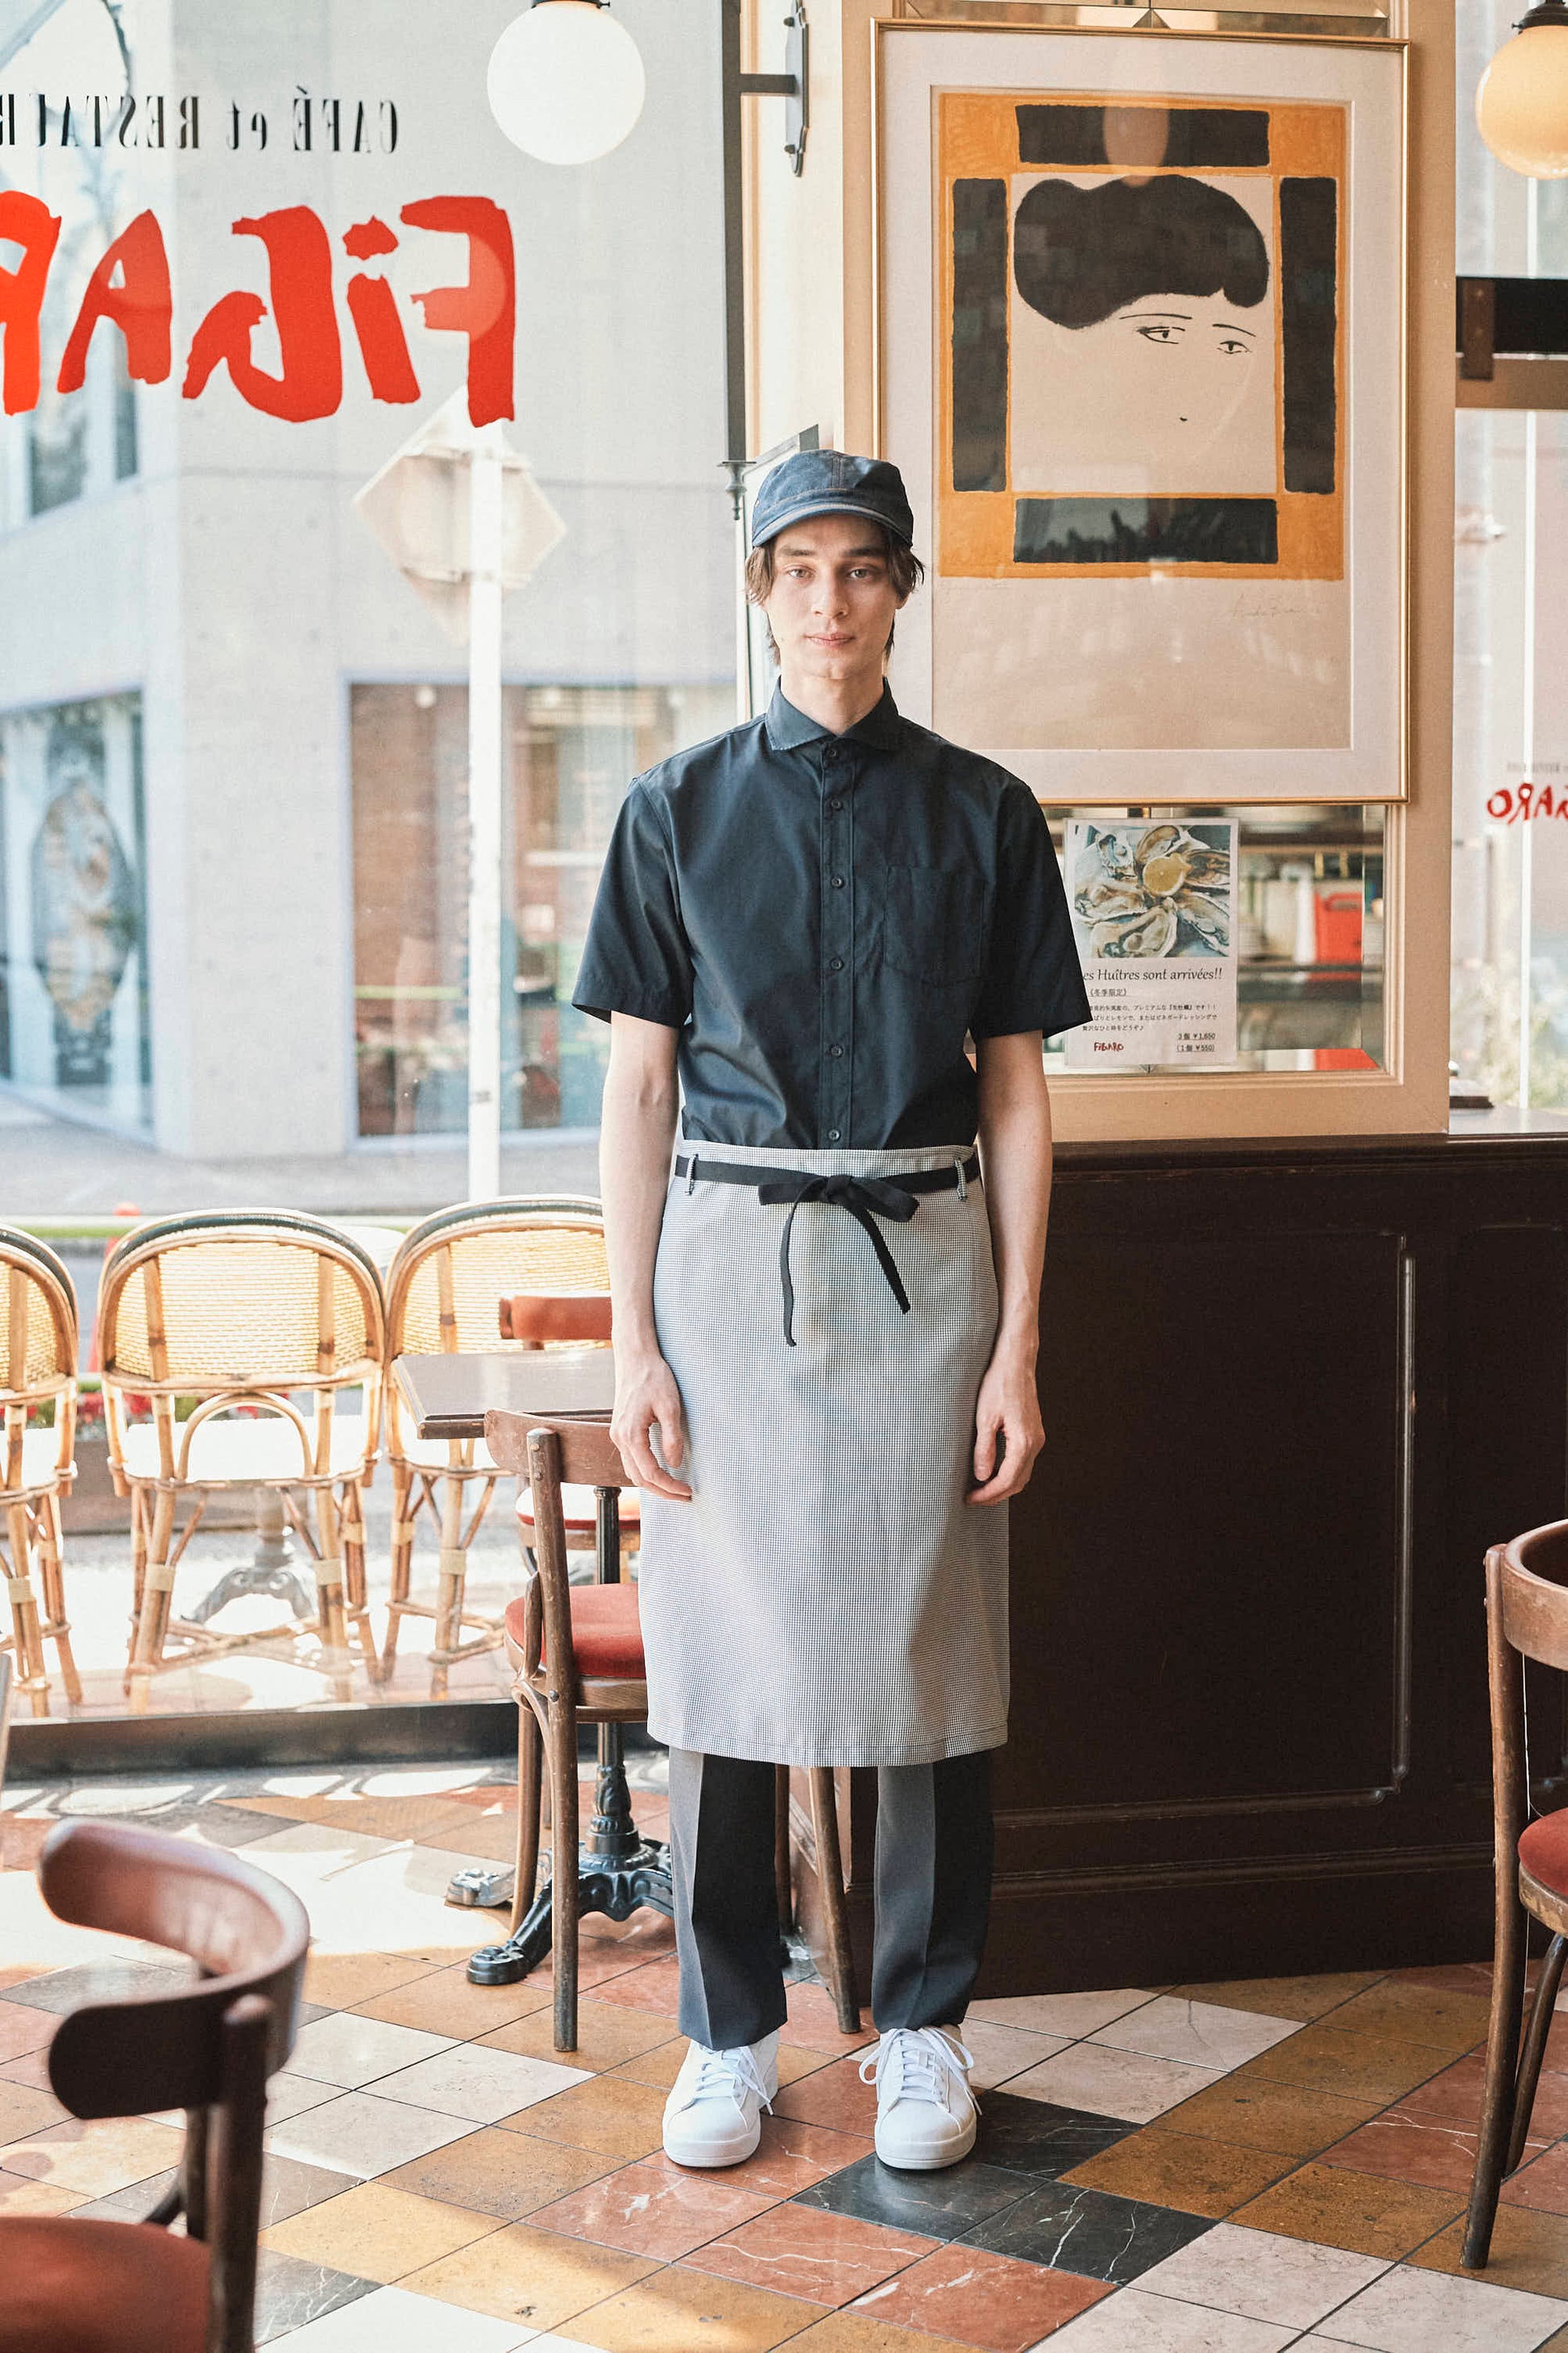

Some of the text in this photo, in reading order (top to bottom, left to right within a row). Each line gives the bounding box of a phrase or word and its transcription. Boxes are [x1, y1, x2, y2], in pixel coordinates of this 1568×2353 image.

[1083, 967, 1222, 981] es Huîtres sont arrivées!!
